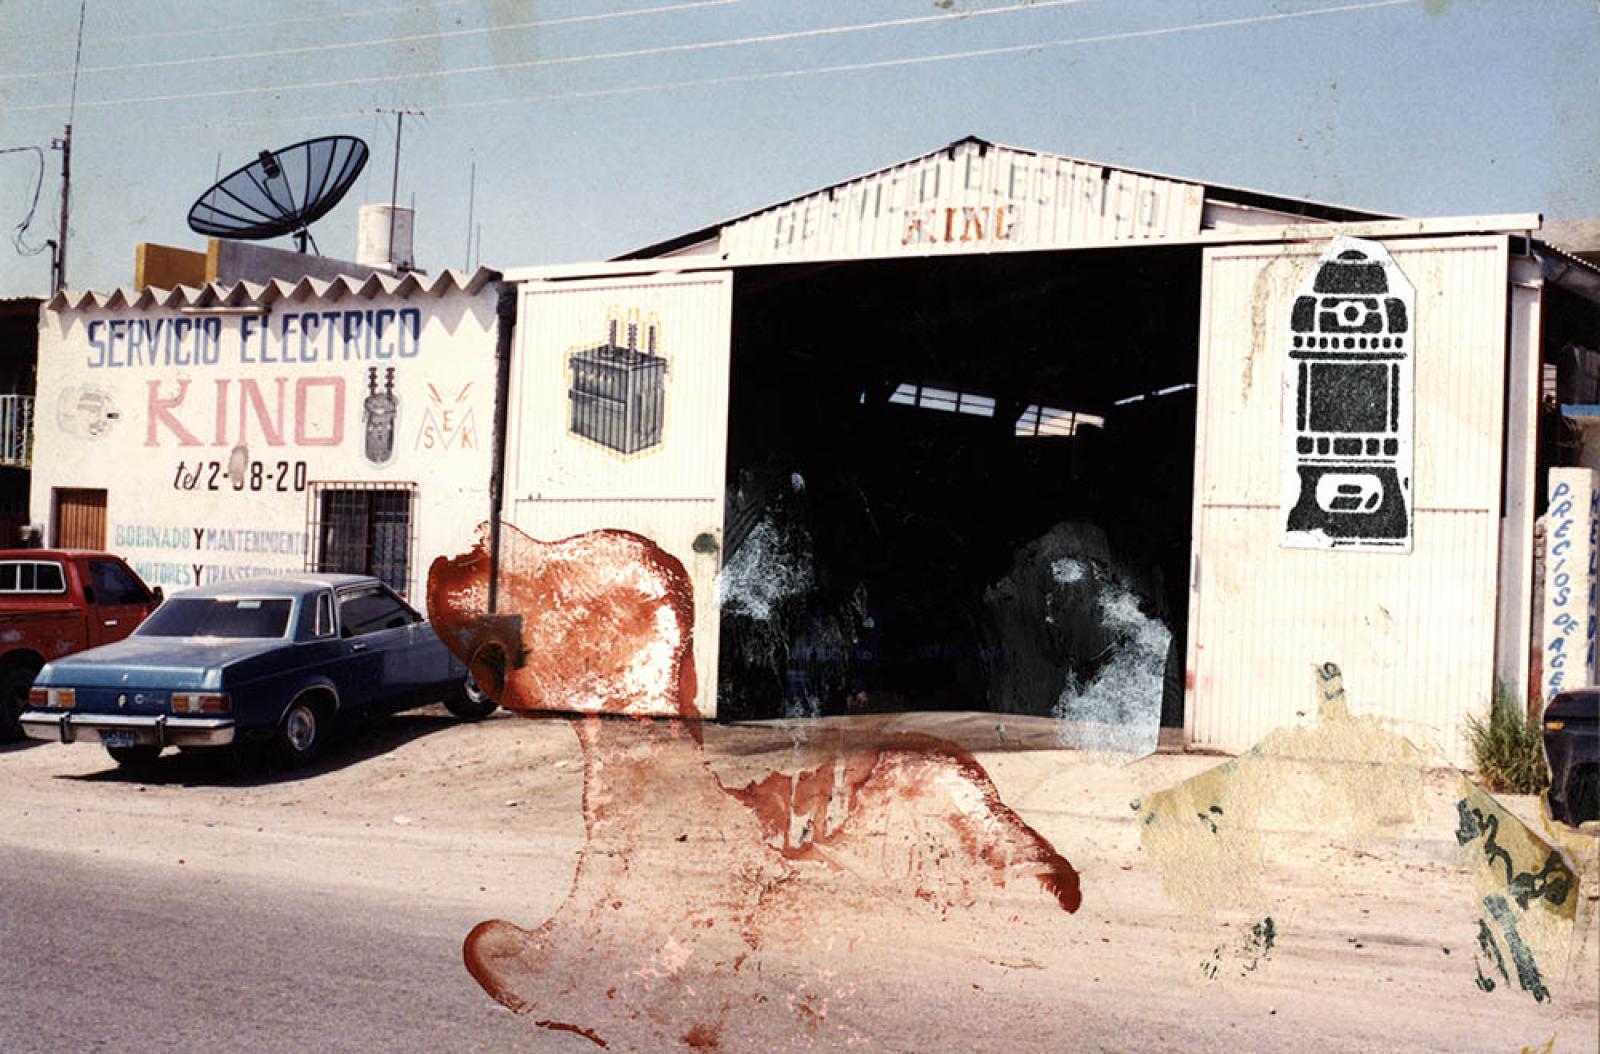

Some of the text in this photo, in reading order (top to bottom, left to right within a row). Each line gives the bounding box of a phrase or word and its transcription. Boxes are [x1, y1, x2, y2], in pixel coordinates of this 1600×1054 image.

[87, 308, 421, 368] SERVICIO ELECTRICO
[143, 376, 347, 447] KINO
[173, 461, 203, 491] tel
[115, 525, 190, 549] BOBINADO
[193, 527, 205, 550] Y
[1551, 481, 1575, 608] PRECIOS
[193, 563, 204, 587] Y
[1552, 612, 1579, 636] DE
